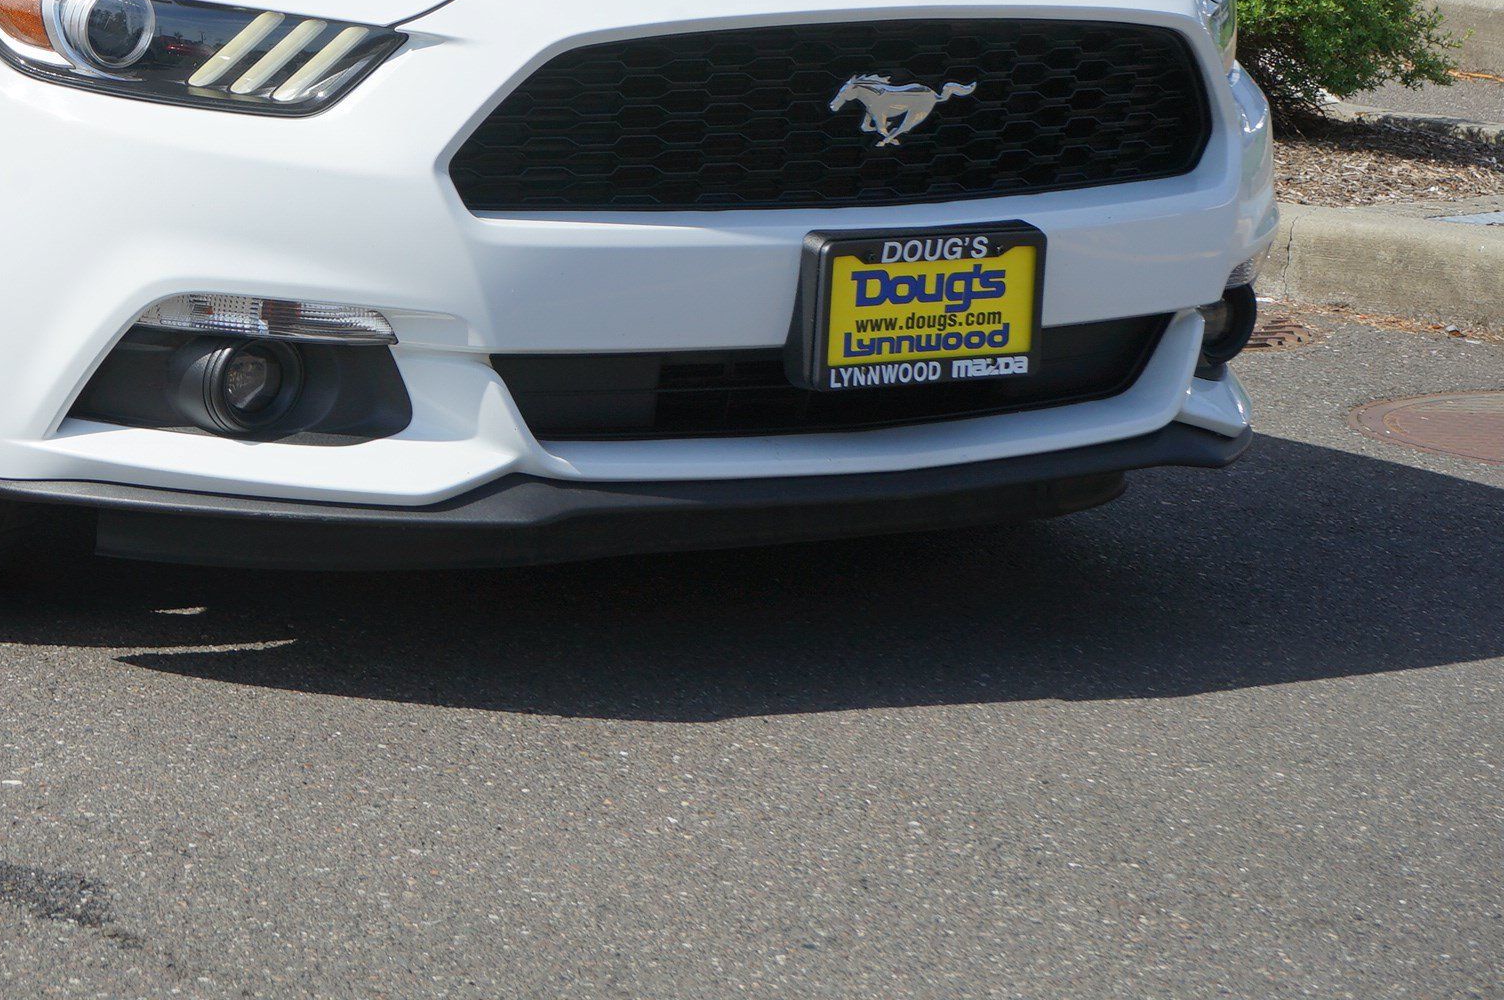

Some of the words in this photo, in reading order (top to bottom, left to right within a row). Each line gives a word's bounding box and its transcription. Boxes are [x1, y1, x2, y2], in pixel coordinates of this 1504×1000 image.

[881, 236, 989, 263] DOUG'S
[851, 264, 1006, 313] Doug's
[856, 311, 1002, 333] www.dougs.com
[843, 322, 1010, 357] Lynnwood
[830, 361, 941, 388] LYNNWOOD
